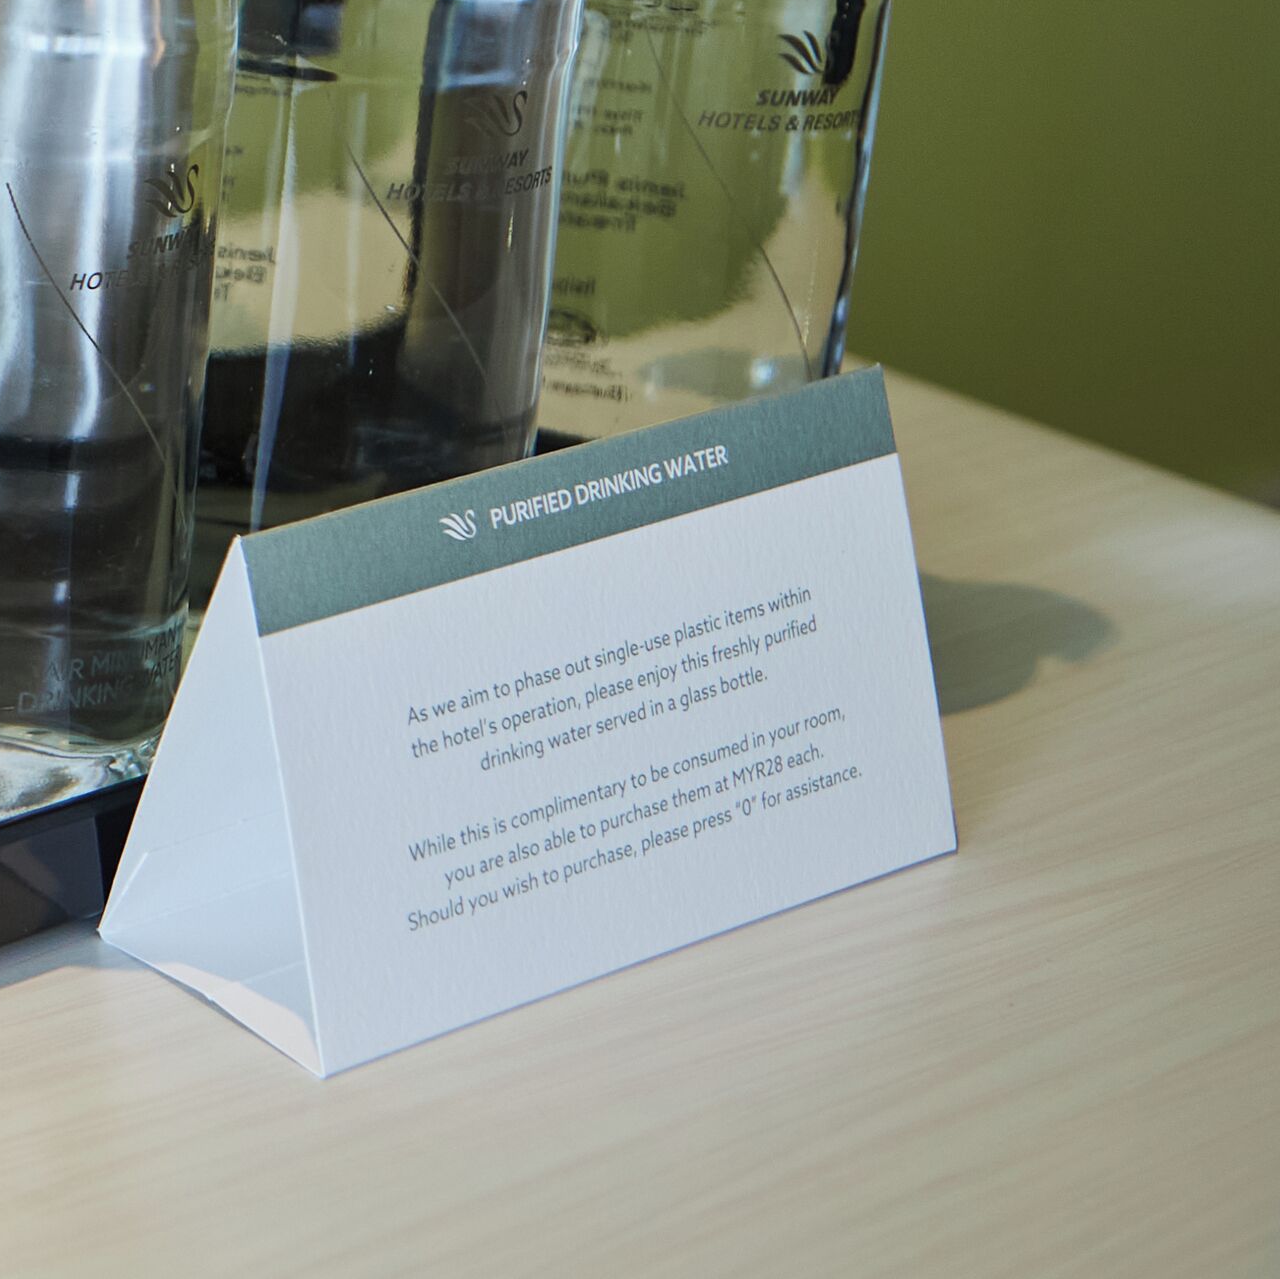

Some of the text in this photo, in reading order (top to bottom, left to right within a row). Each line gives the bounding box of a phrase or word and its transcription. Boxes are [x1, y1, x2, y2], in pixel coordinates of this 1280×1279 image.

[698, 109, 862, 131] HOTELS & RESORT
[756, 87, 839, 107] SUNWAY
[492, 166, 552, 197] ESORTS
[490, 444, 729, 529] PURIFIED DRINKING WATER
[407, 586, 812, 727] As we aim to phase out single-use plastic items within
[410, 737, 440, 759] the
[500, 695, 582, 733] operation,
[584, 677, 635, 710] please
[636, 663, 678, 689] enjoy
[680, 650, 710, 674] this
[711, 633, 761, 665] freshly
[763, 613, 818, 653] purified
[480, 665, 768, 772] drinking water served in a glass bottle.
[408, 707, 846, 862] While this is complimentary to be consumed in your room,
[444, 742, 825, 891] you are also able to purchase them at MYR28 each.
[407, 895, 465, 932] Should
[467, 890, 499, 917] you
[501, 871, 540, 900] wish
[541, 869, 560, 886] to
[562, 843, 638, 884] purchase,
[640, 824, 690, 857] please
[692, 809, 733, 840] press
[761, 790, 782, 811] for
[785, 765, 863, 802] assistance.
